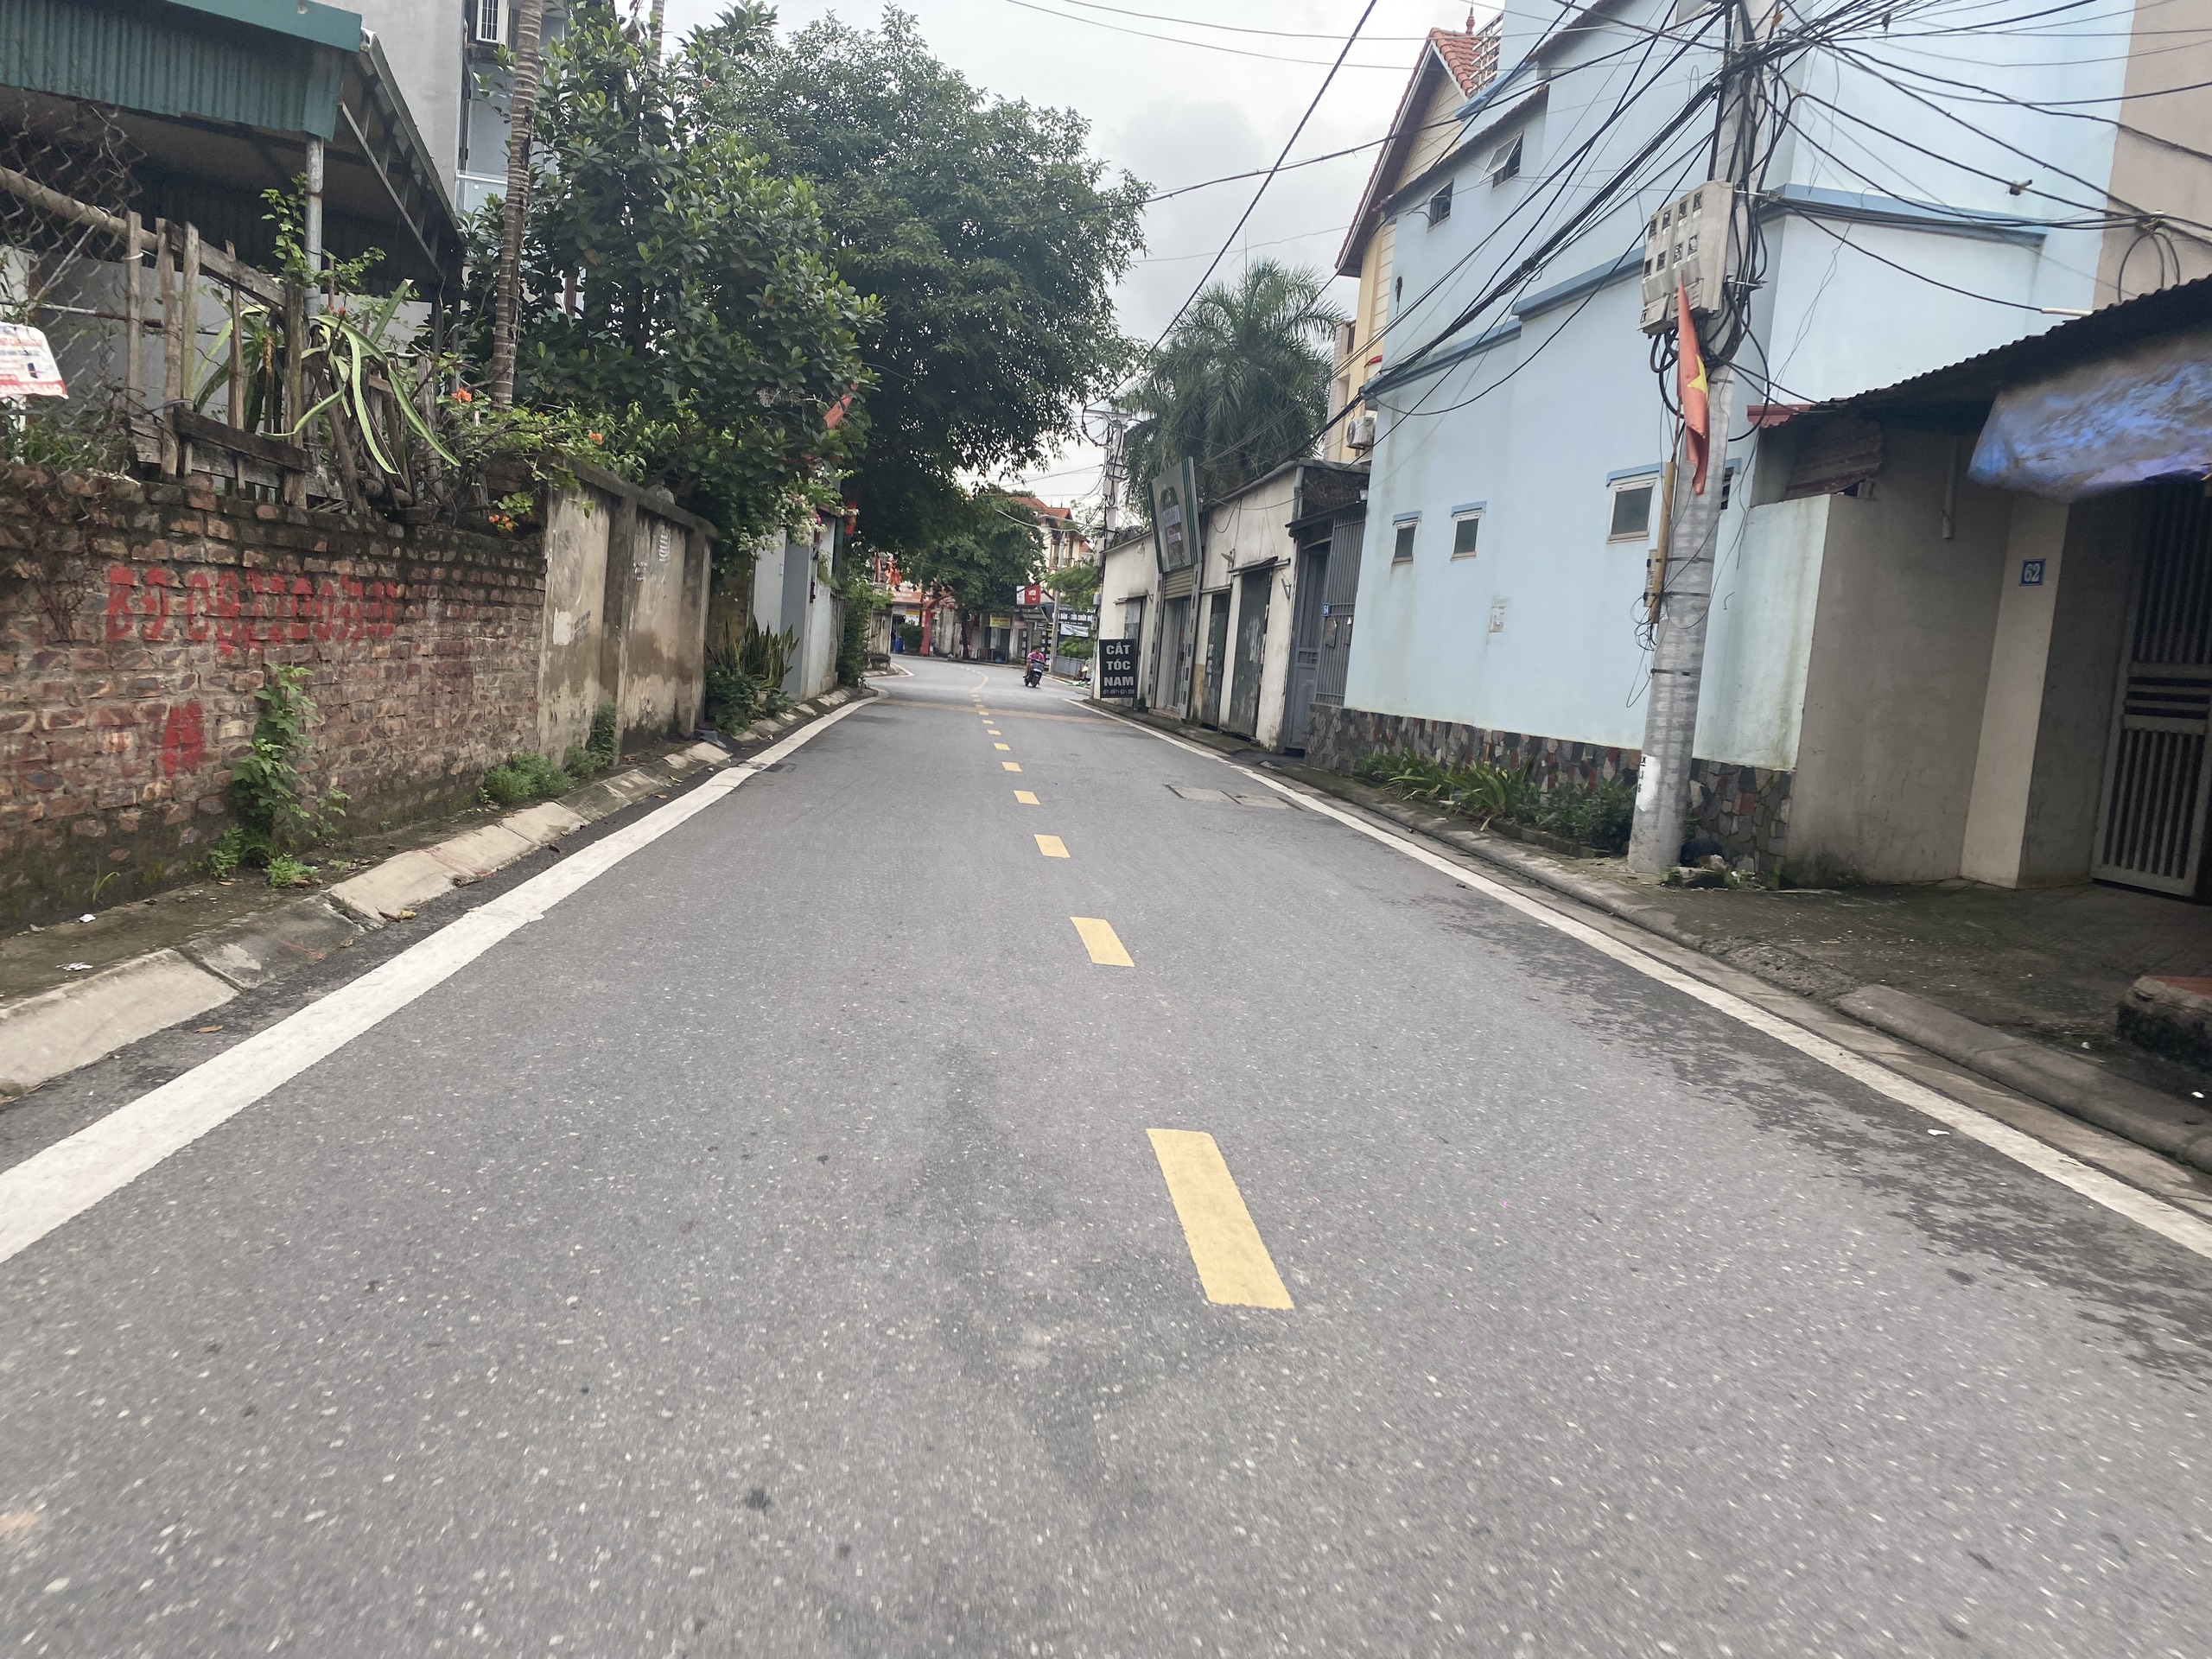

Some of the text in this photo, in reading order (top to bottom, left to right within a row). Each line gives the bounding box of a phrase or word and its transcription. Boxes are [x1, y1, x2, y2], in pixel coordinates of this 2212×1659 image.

[2024, 563, 2041, 582] 62
[1106, 642, 1131, 655] CẮT
[1106, 658, 1131, 671] TÓC
[1103, 677, 1135, 687] NAM
